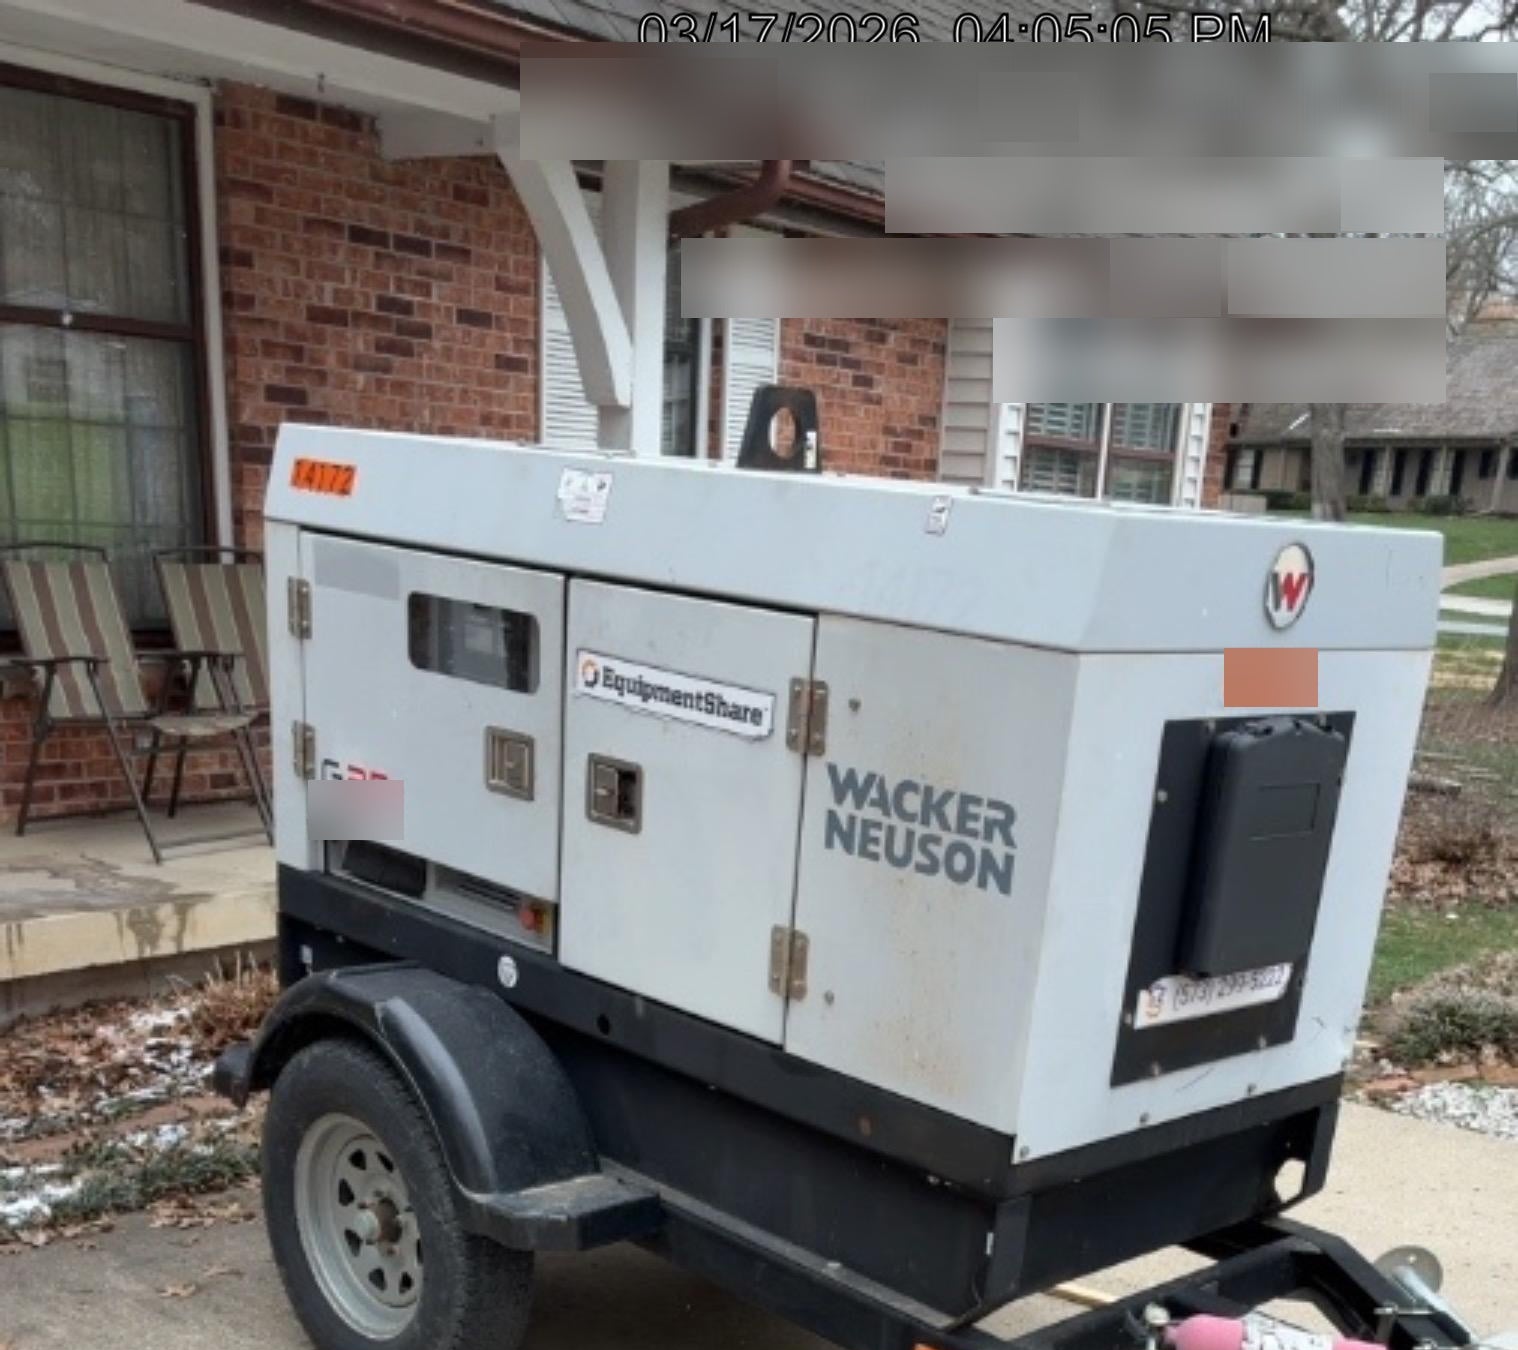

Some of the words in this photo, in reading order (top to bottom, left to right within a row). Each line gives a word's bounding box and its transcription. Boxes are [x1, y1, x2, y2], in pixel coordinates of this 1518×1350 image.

[601, 666, 763, 726] EquipmentShare
[827, 762, 1017, 849] WACKER
[824, 809, 1015, 896] NEUSON
